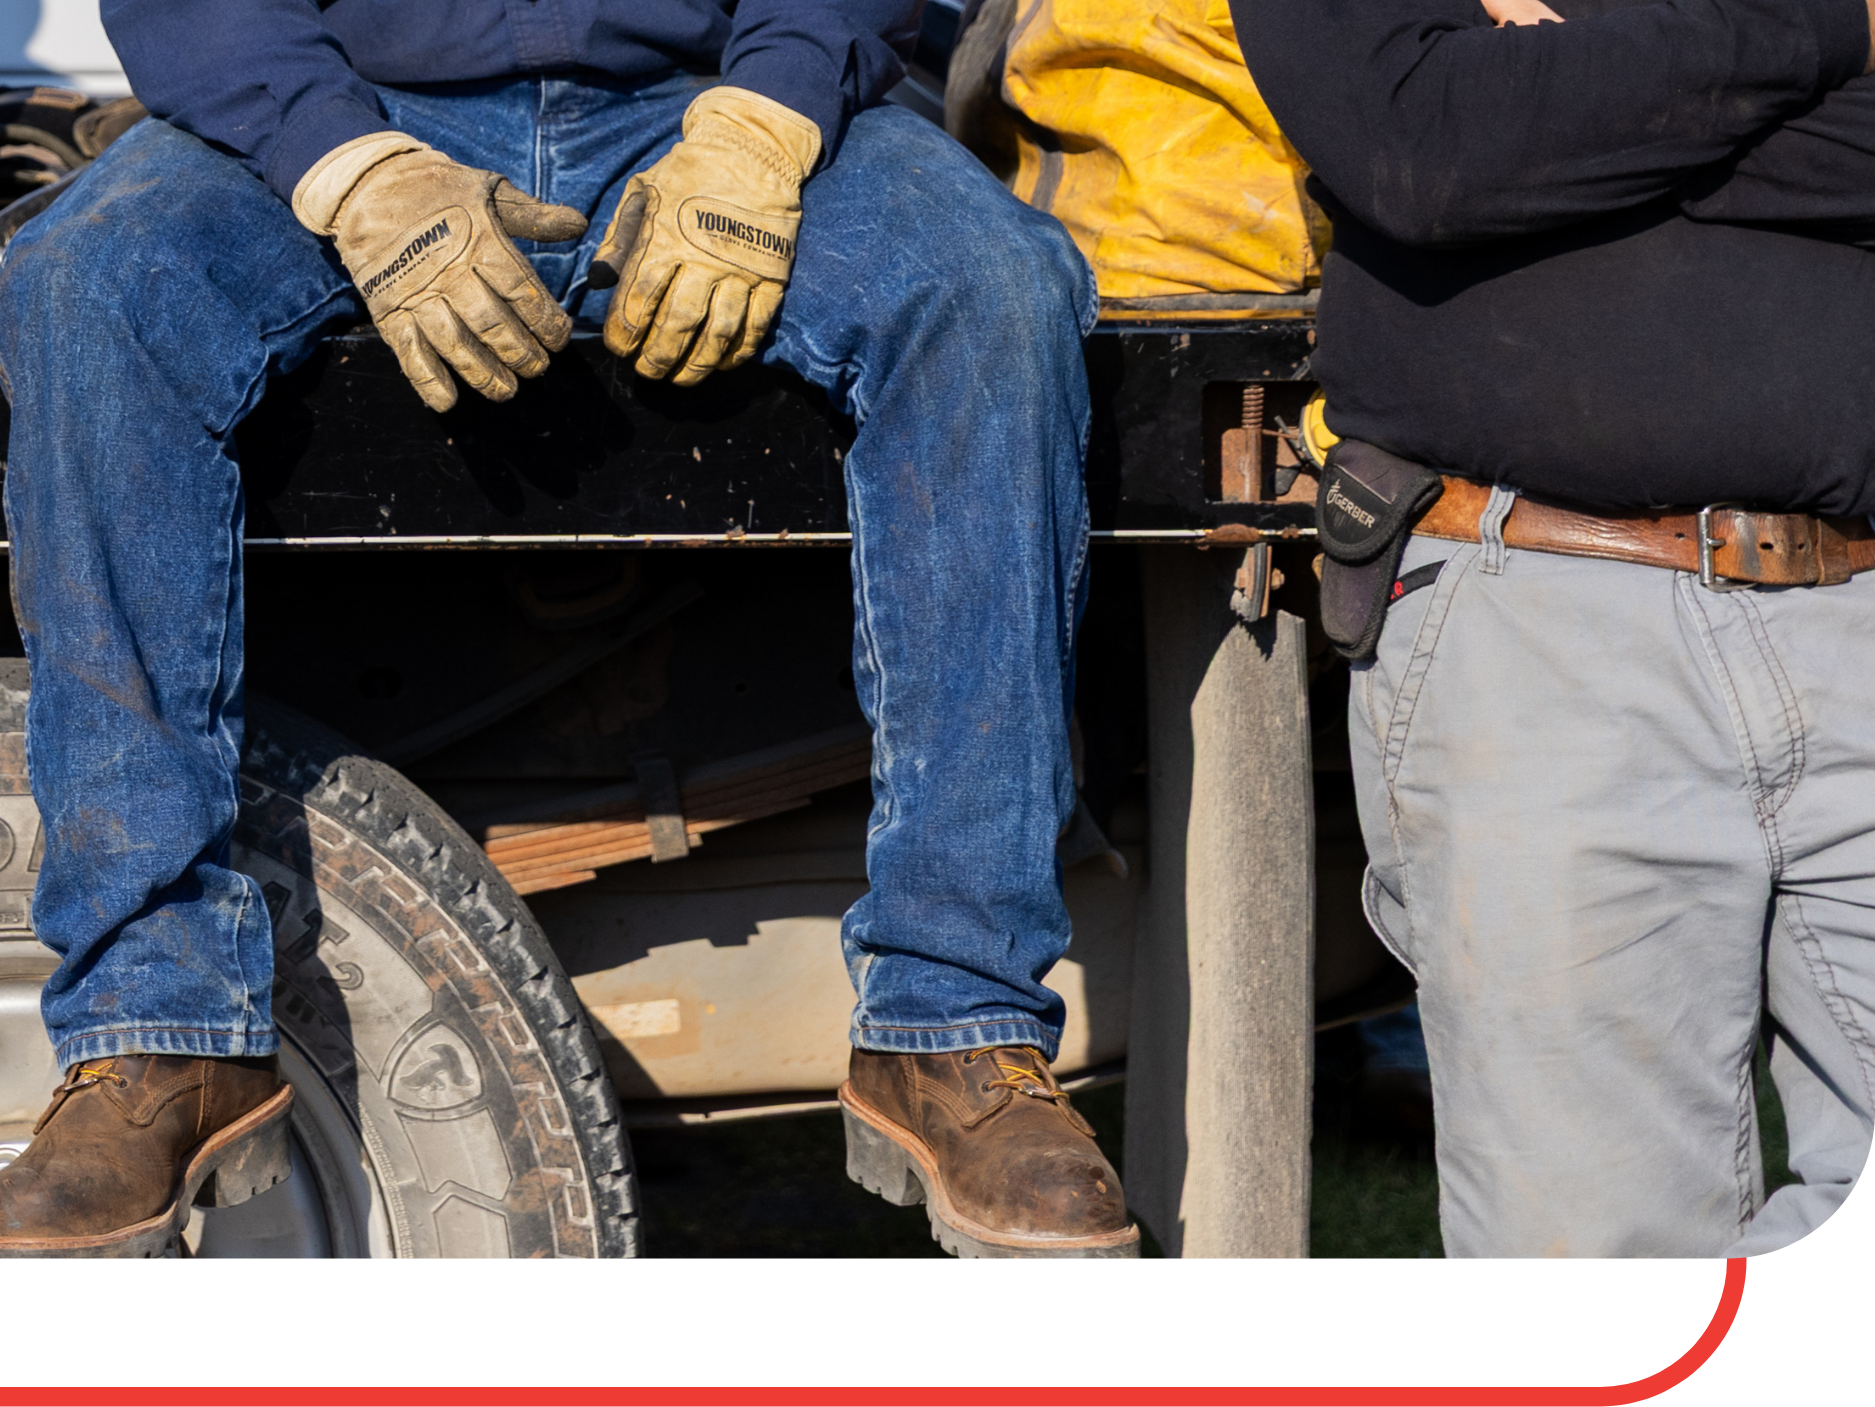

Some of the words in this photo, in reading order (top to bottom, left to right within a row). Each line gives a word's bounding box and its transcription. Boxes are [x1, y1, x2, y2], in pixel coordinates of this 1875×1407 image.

[696, 209, 792, 260] YOUNGSTOWN
[362, 218, 452, 299] YOUNGSTOWN
[399, 253, 430, 280] COMPANY
[1334, 493, 1375, 528] GERBER
